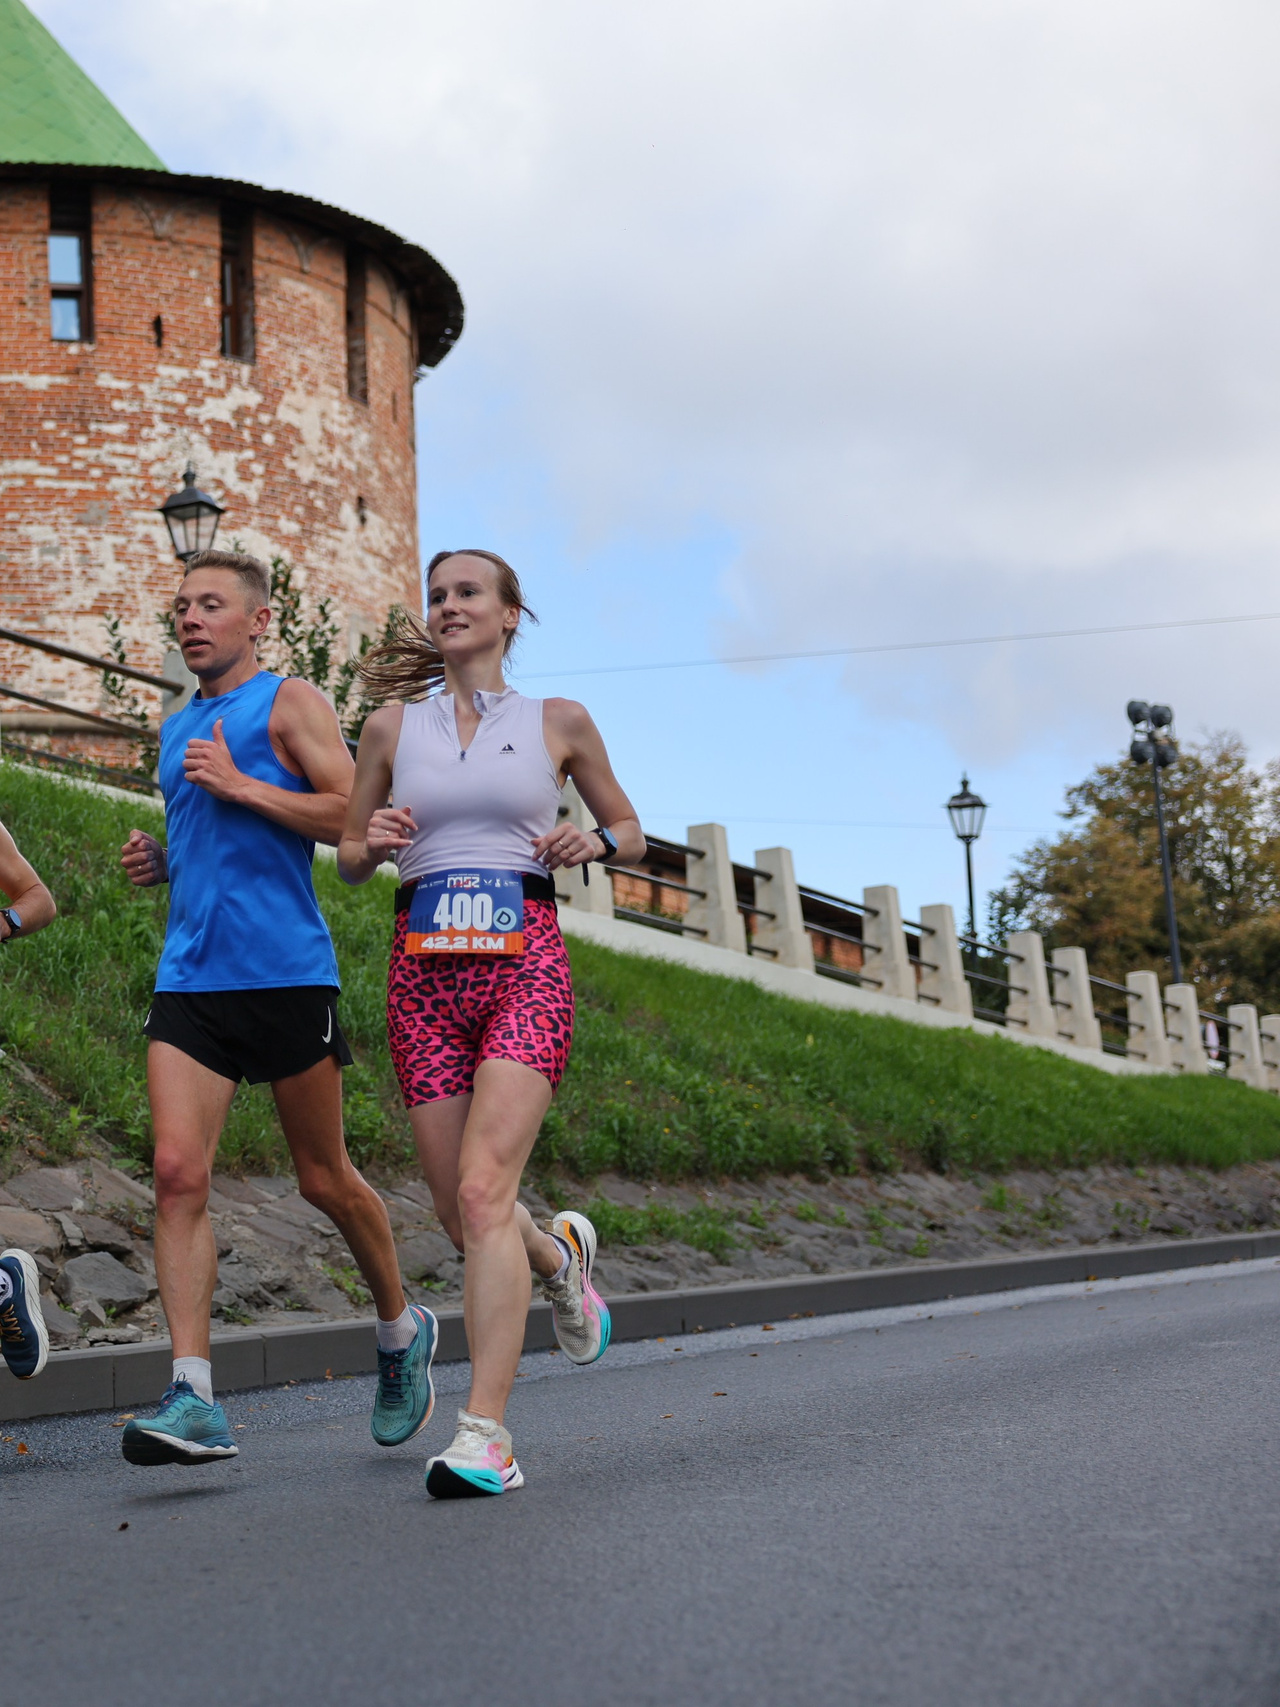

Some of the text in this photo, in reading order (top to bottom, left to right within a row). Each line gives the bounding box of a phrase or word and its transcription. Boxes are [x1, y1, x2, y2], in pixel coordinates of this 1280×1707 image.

[433, 893, 493, 931] 400
[421, 936, 504, 950] 42,2 KM
